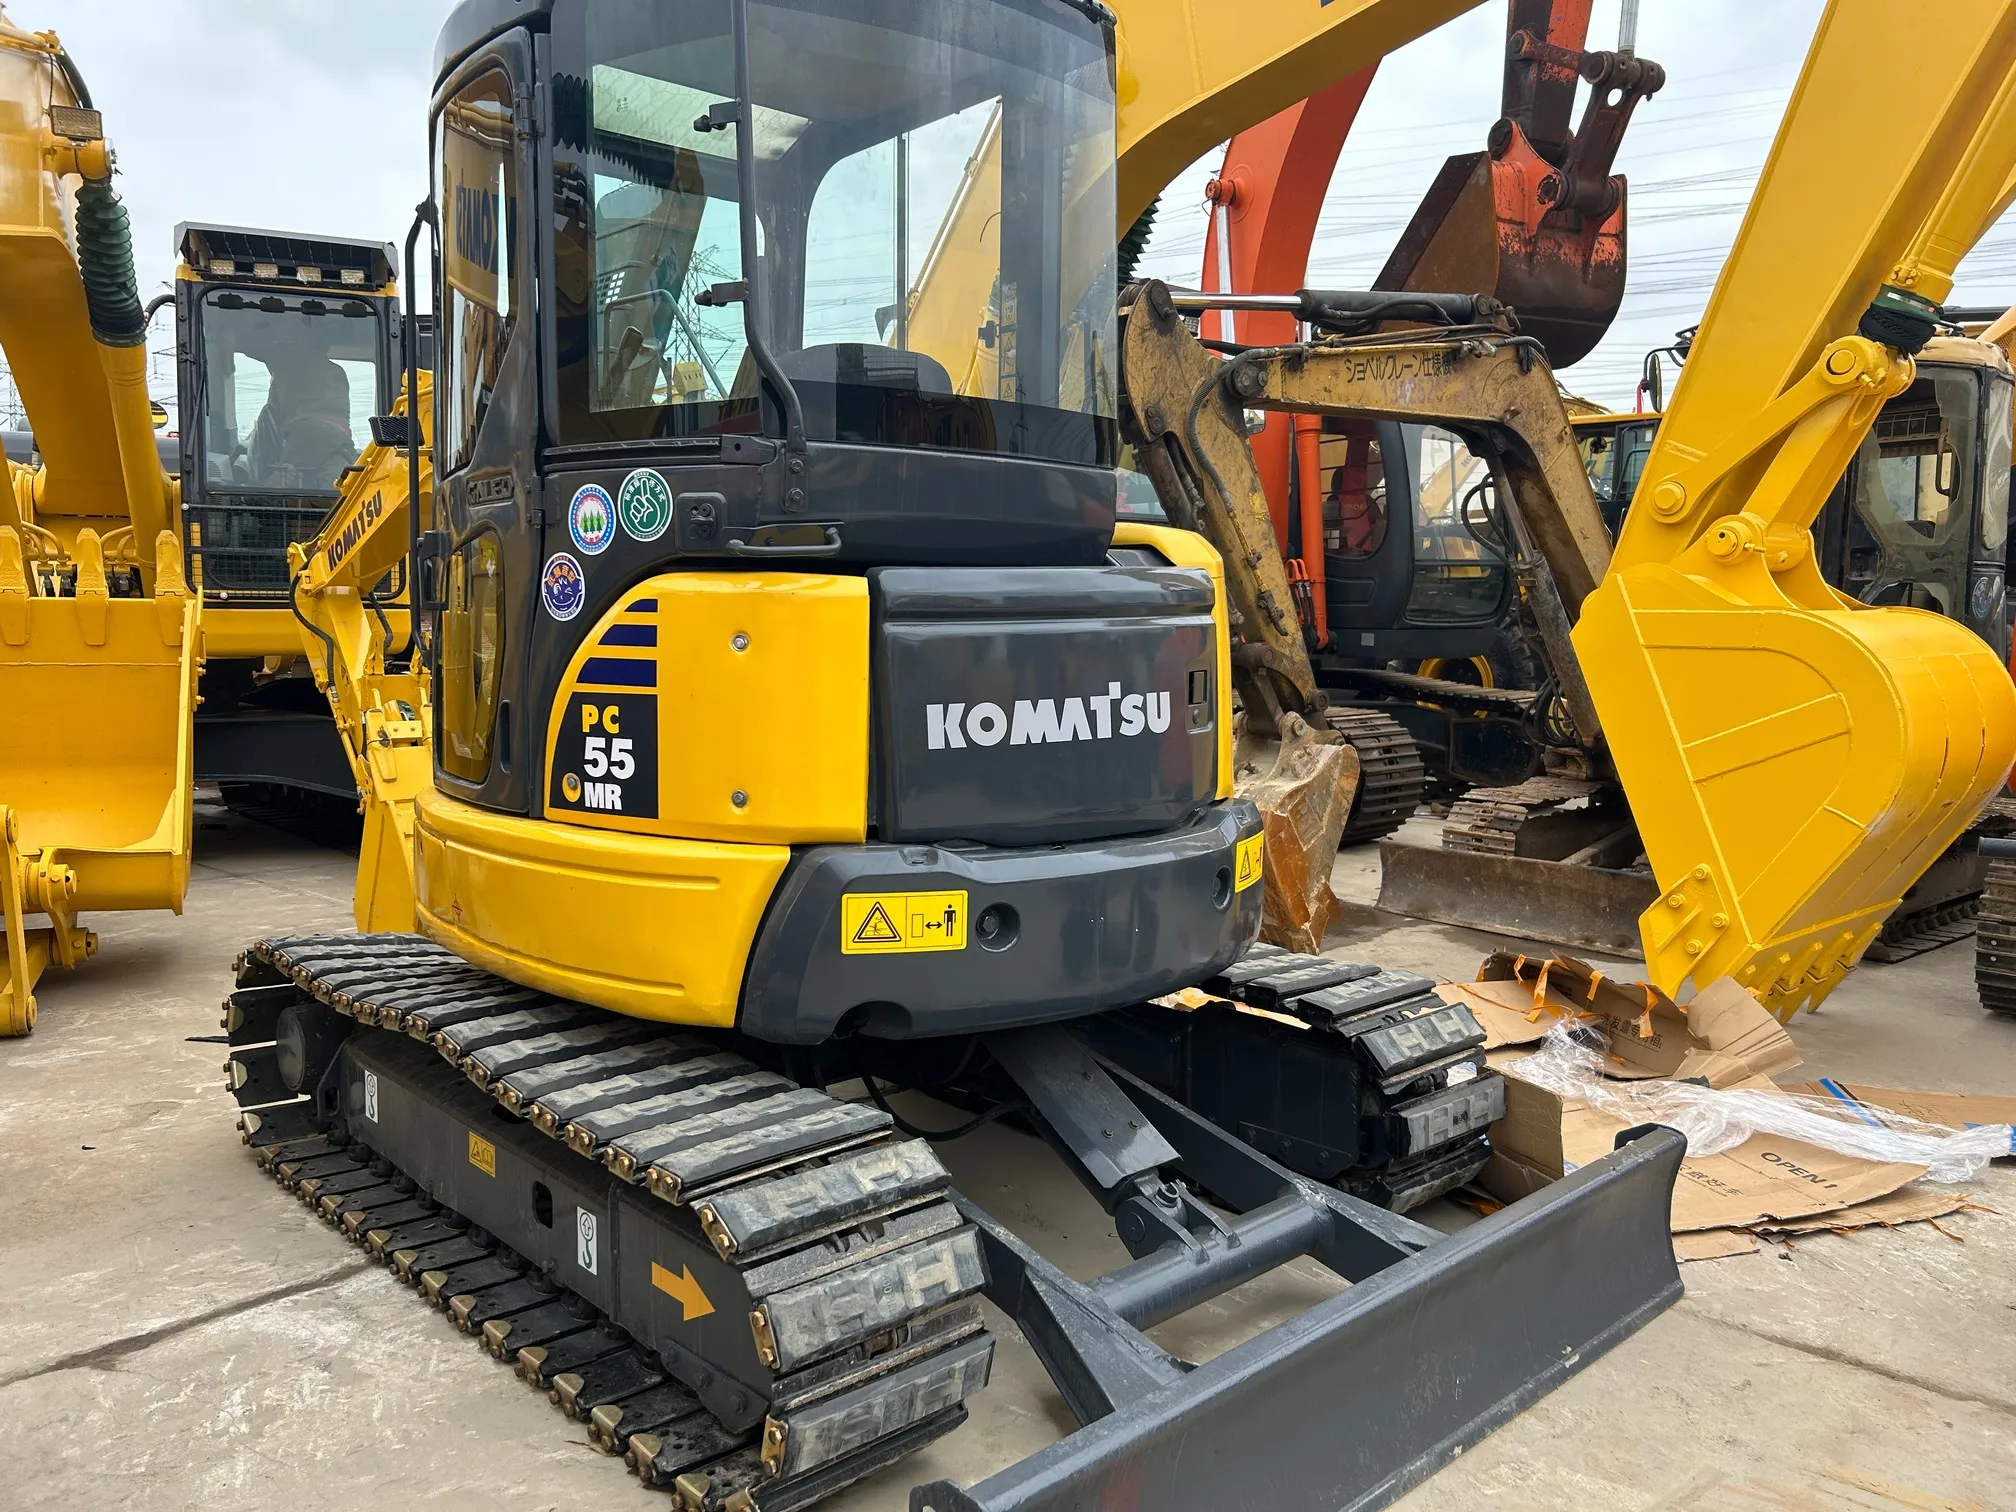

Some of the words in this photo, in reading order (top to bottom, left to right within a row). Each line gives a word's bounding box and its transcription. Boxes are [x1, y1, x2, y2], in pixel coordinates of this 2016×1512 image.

[327, 489, 382, 572] KOMATSU
[581, 704, 619, 734] PC
[926, 681, 1171, 750] KOMATSU
[583, 736, 635, 780] 55
[584, 781, 623, 810] MR
[1761, 1152, 1827, 1184] OPEN
